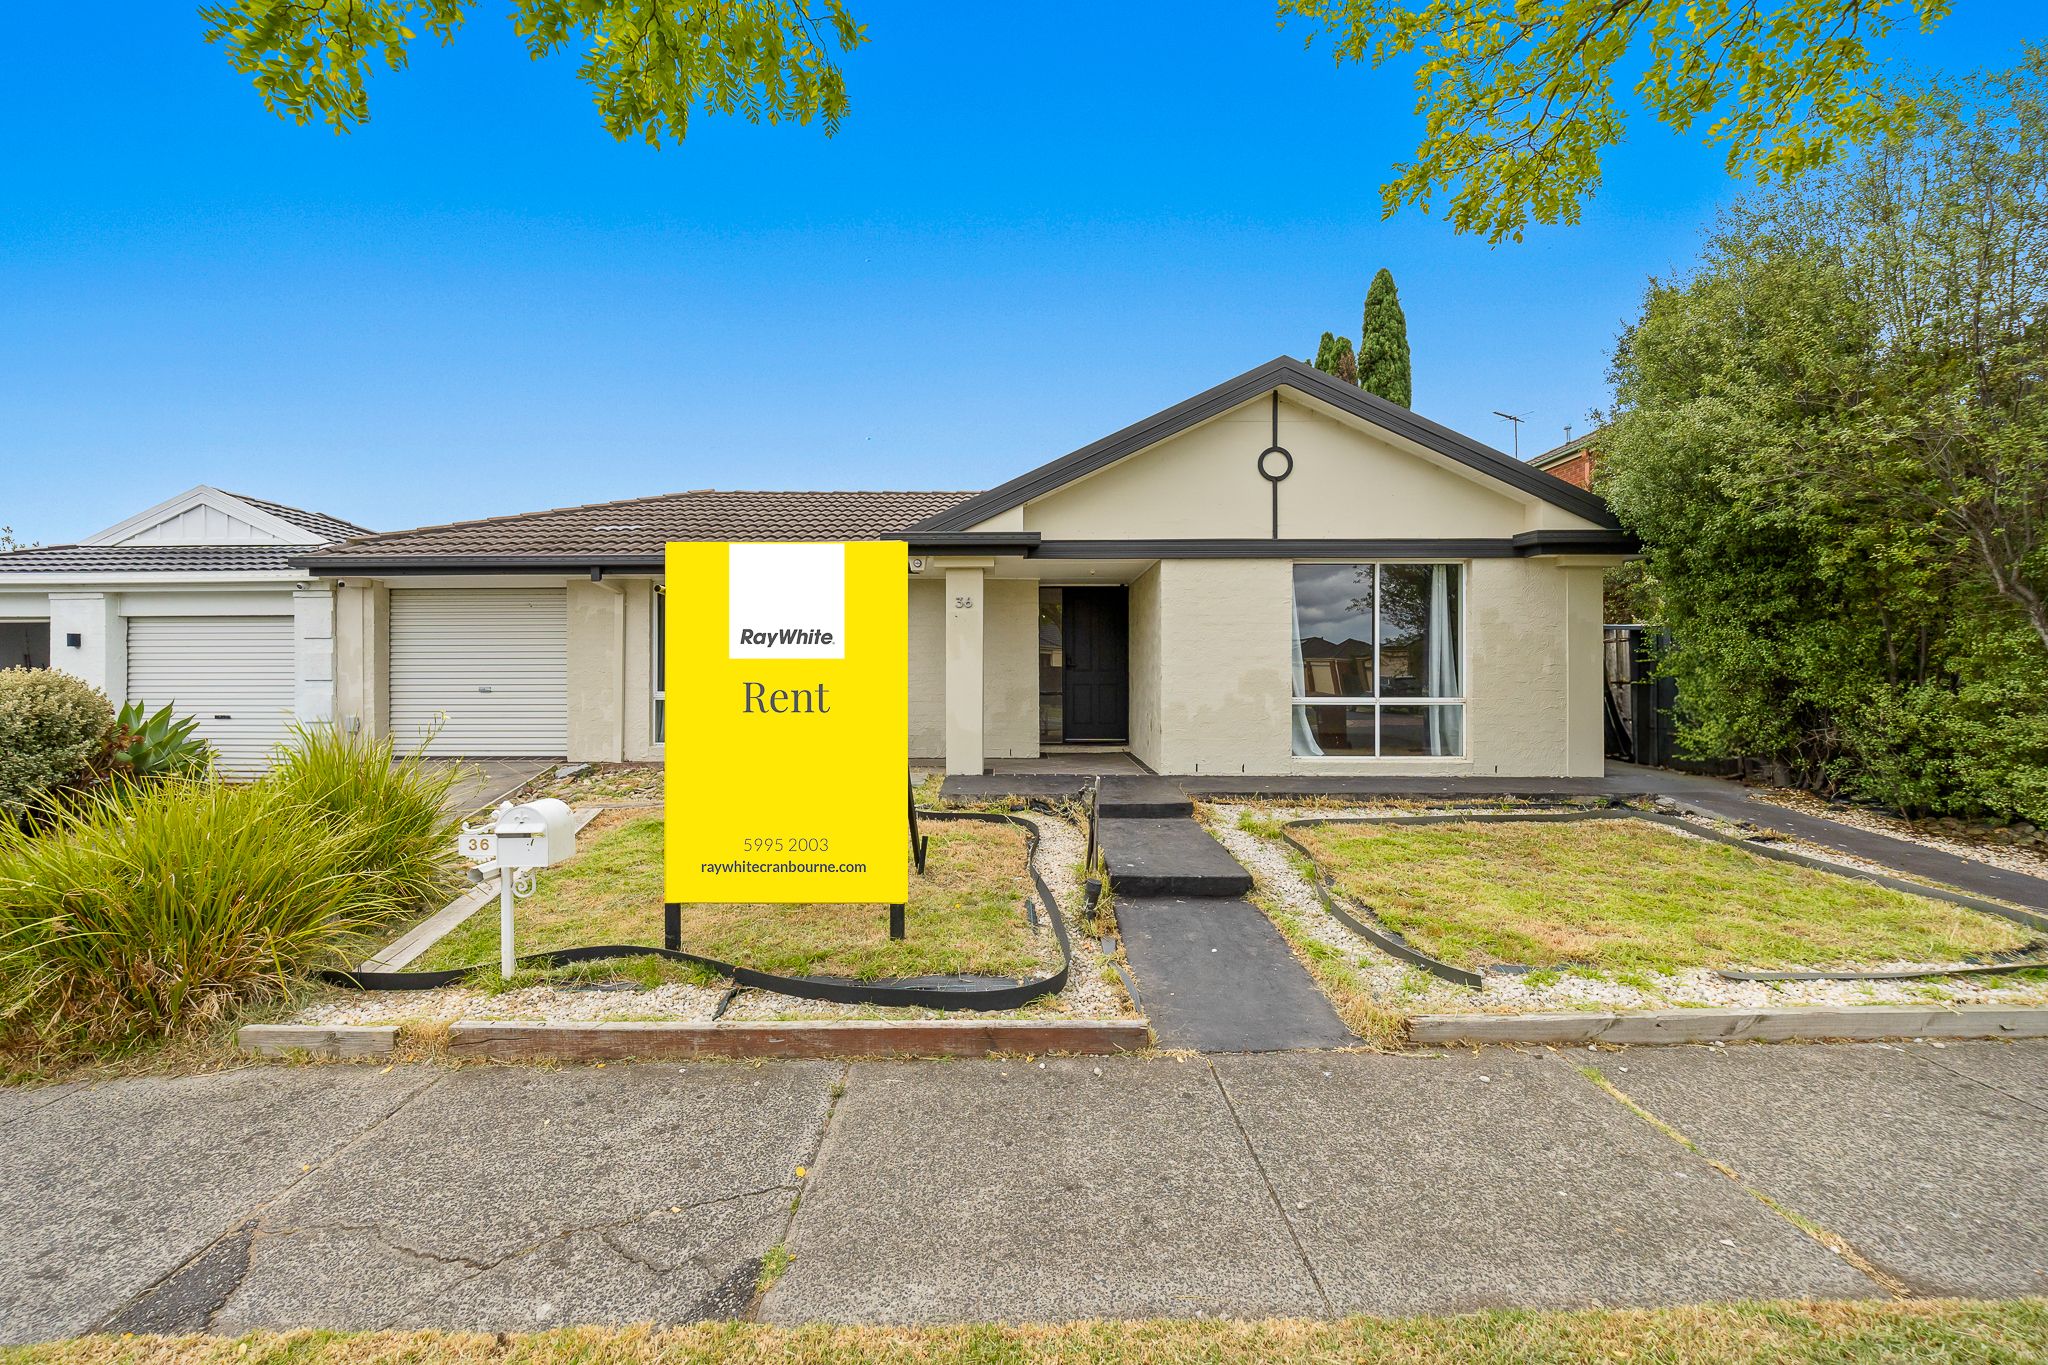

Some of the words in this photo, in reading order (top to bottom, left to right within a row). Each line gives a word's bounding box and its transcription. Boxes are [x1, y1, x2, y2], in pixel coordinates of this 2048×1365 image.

[955, 597, 973, 609] 36
[743, 681, 831, 714] Rent
[468, 838, 490, 851] 36
[743, 838, 784, 852] 5995
[788, 838, 829, 852] 2003
[701, 860, 867, 876] raywhitecranbourne.com
